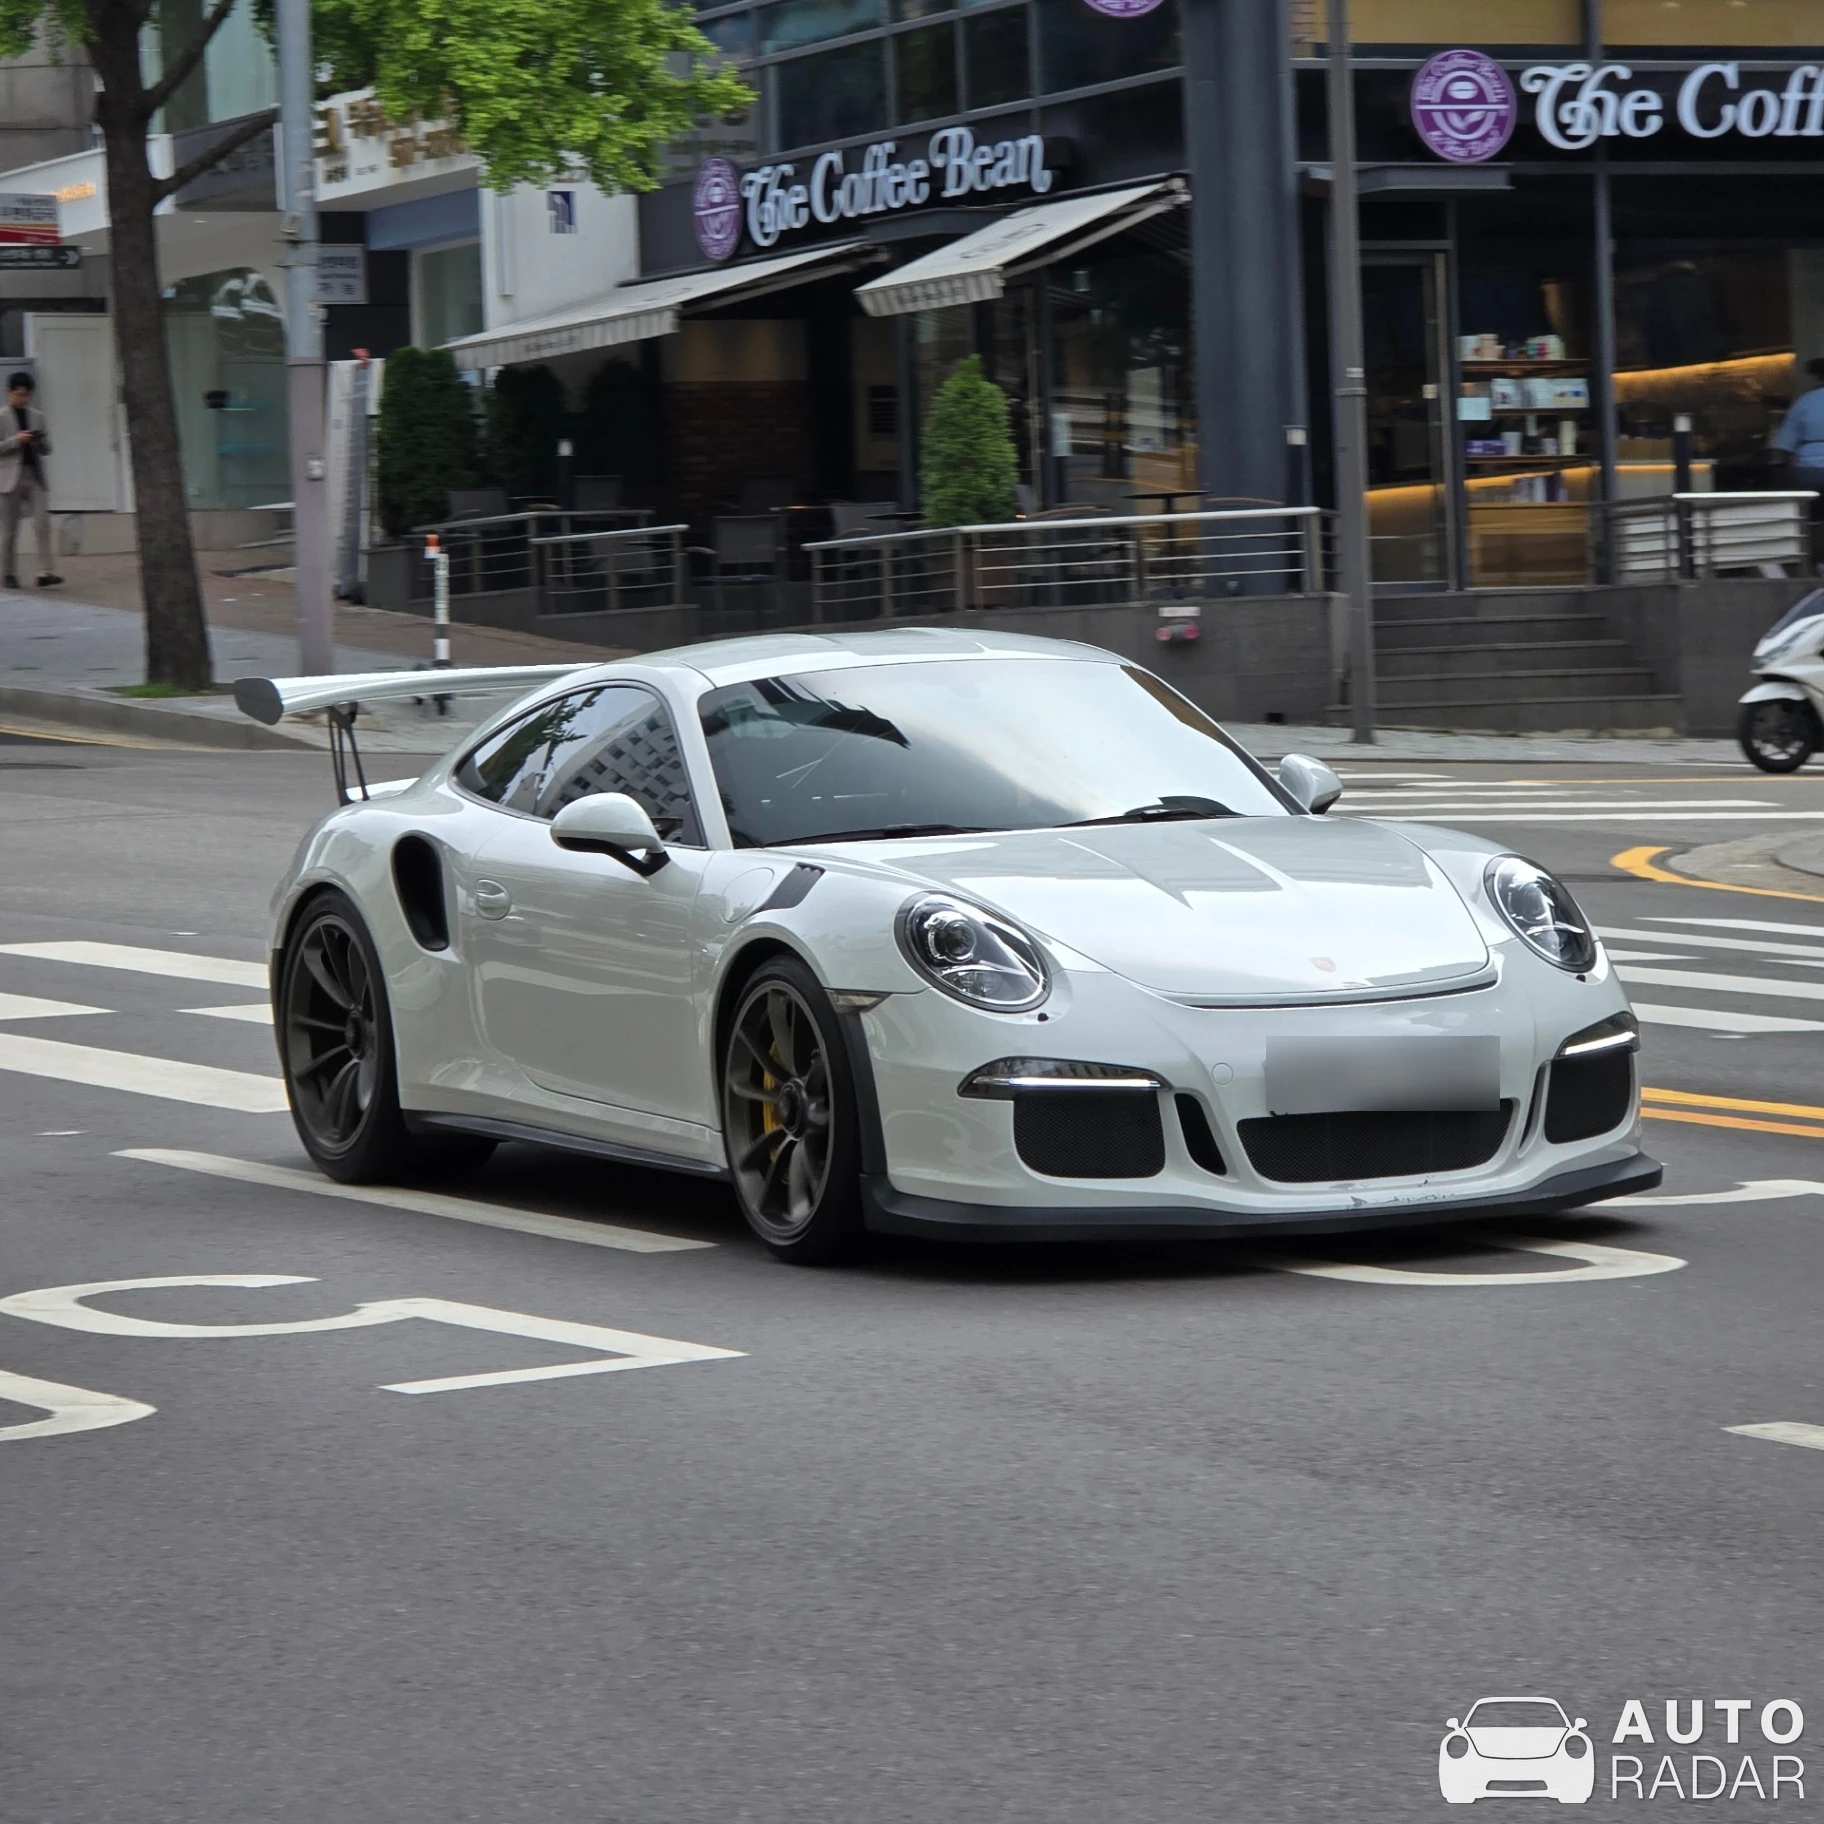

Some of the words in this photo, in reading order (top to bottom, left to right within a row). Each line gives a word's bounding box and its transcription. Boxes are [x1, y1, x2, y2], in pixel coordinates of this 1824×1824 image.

[1520, 63, 1663, 150] The
[741, 163, 809, 247] The
[811, 141, 930, 223] Coffee
[929, 126, 1052, 198] Bean
